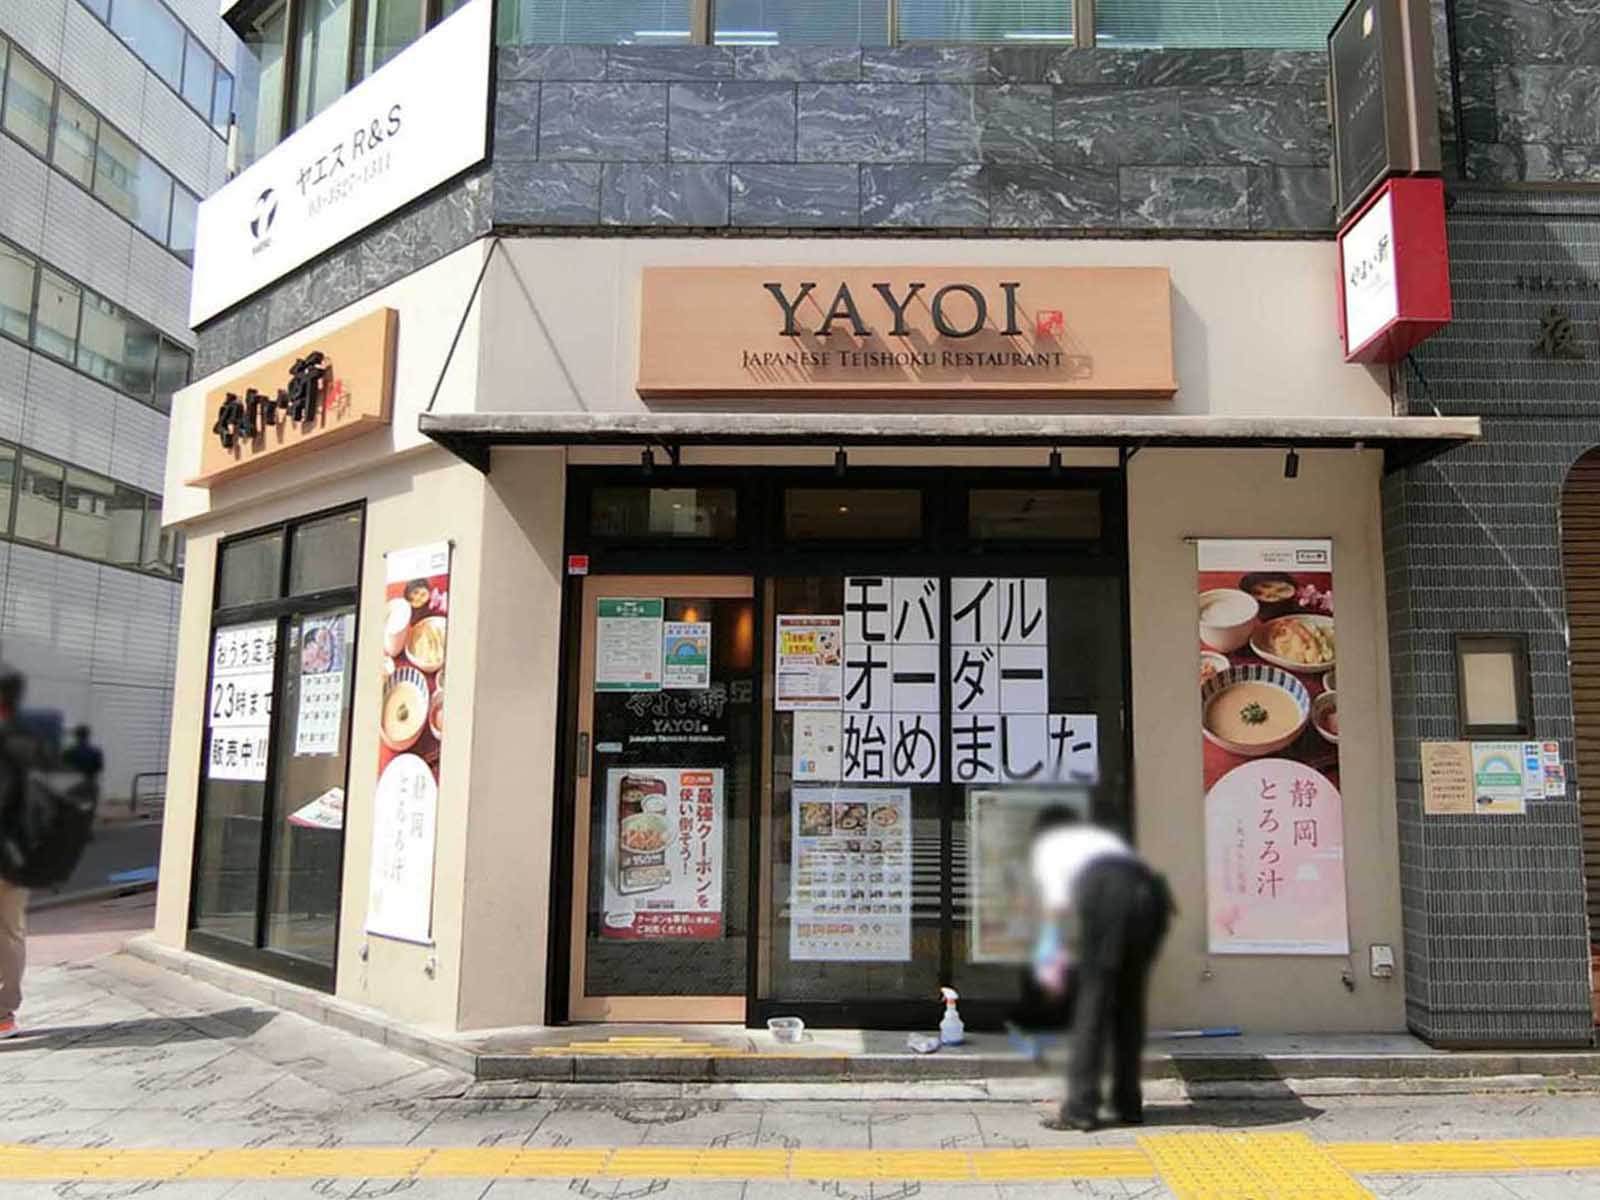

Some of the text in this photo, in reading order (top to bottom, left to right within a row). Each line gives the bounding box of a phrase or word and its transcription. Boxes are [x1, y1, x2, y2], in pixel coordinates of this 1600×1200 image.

[296, 104, 402, 196] ヤエス R&S
[763, 282, 1024, 338] YAYOI
[742, 351, 1066, 368] JAPANESE TEISHOKU RESTAURANT
[845, 578, 1043, 643] モバイル
[845, 644, 1044, 711] オーダー
[844, 714, 1093, 781] 始めました
[1256, 778, 1284, 899] とろろ汁
[1290, 779, 1318, 848] 静岡
